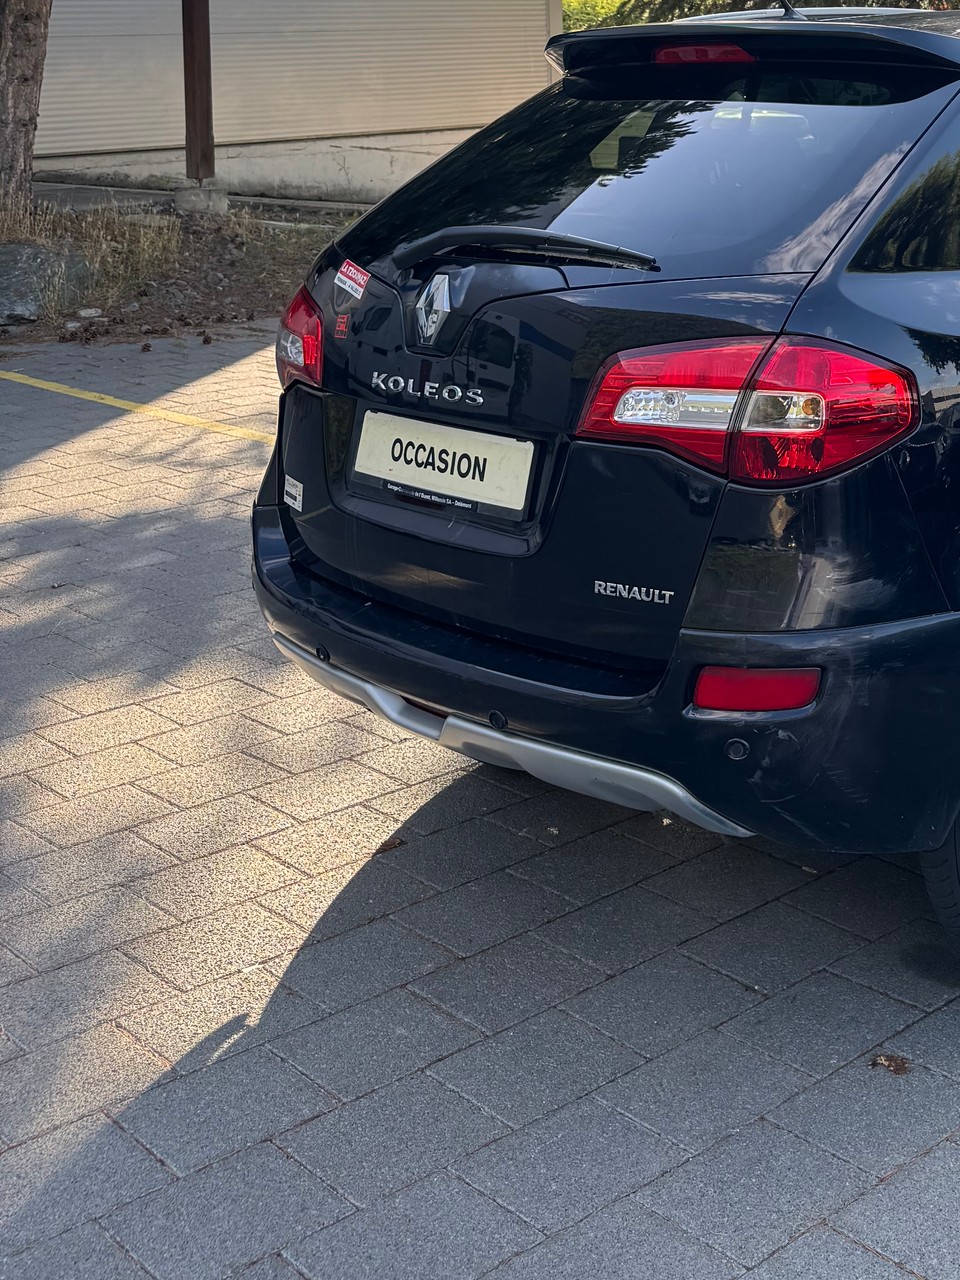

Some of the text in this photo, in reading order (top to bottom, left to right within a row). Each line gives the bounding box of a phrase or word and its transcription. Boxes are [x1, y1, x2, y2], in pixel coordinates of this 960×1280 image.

[371, 371, 485, 406] KOLEOS
[391, 437, 488, 482] OCCASION
[594, 580, 675, 605] RENAULT
